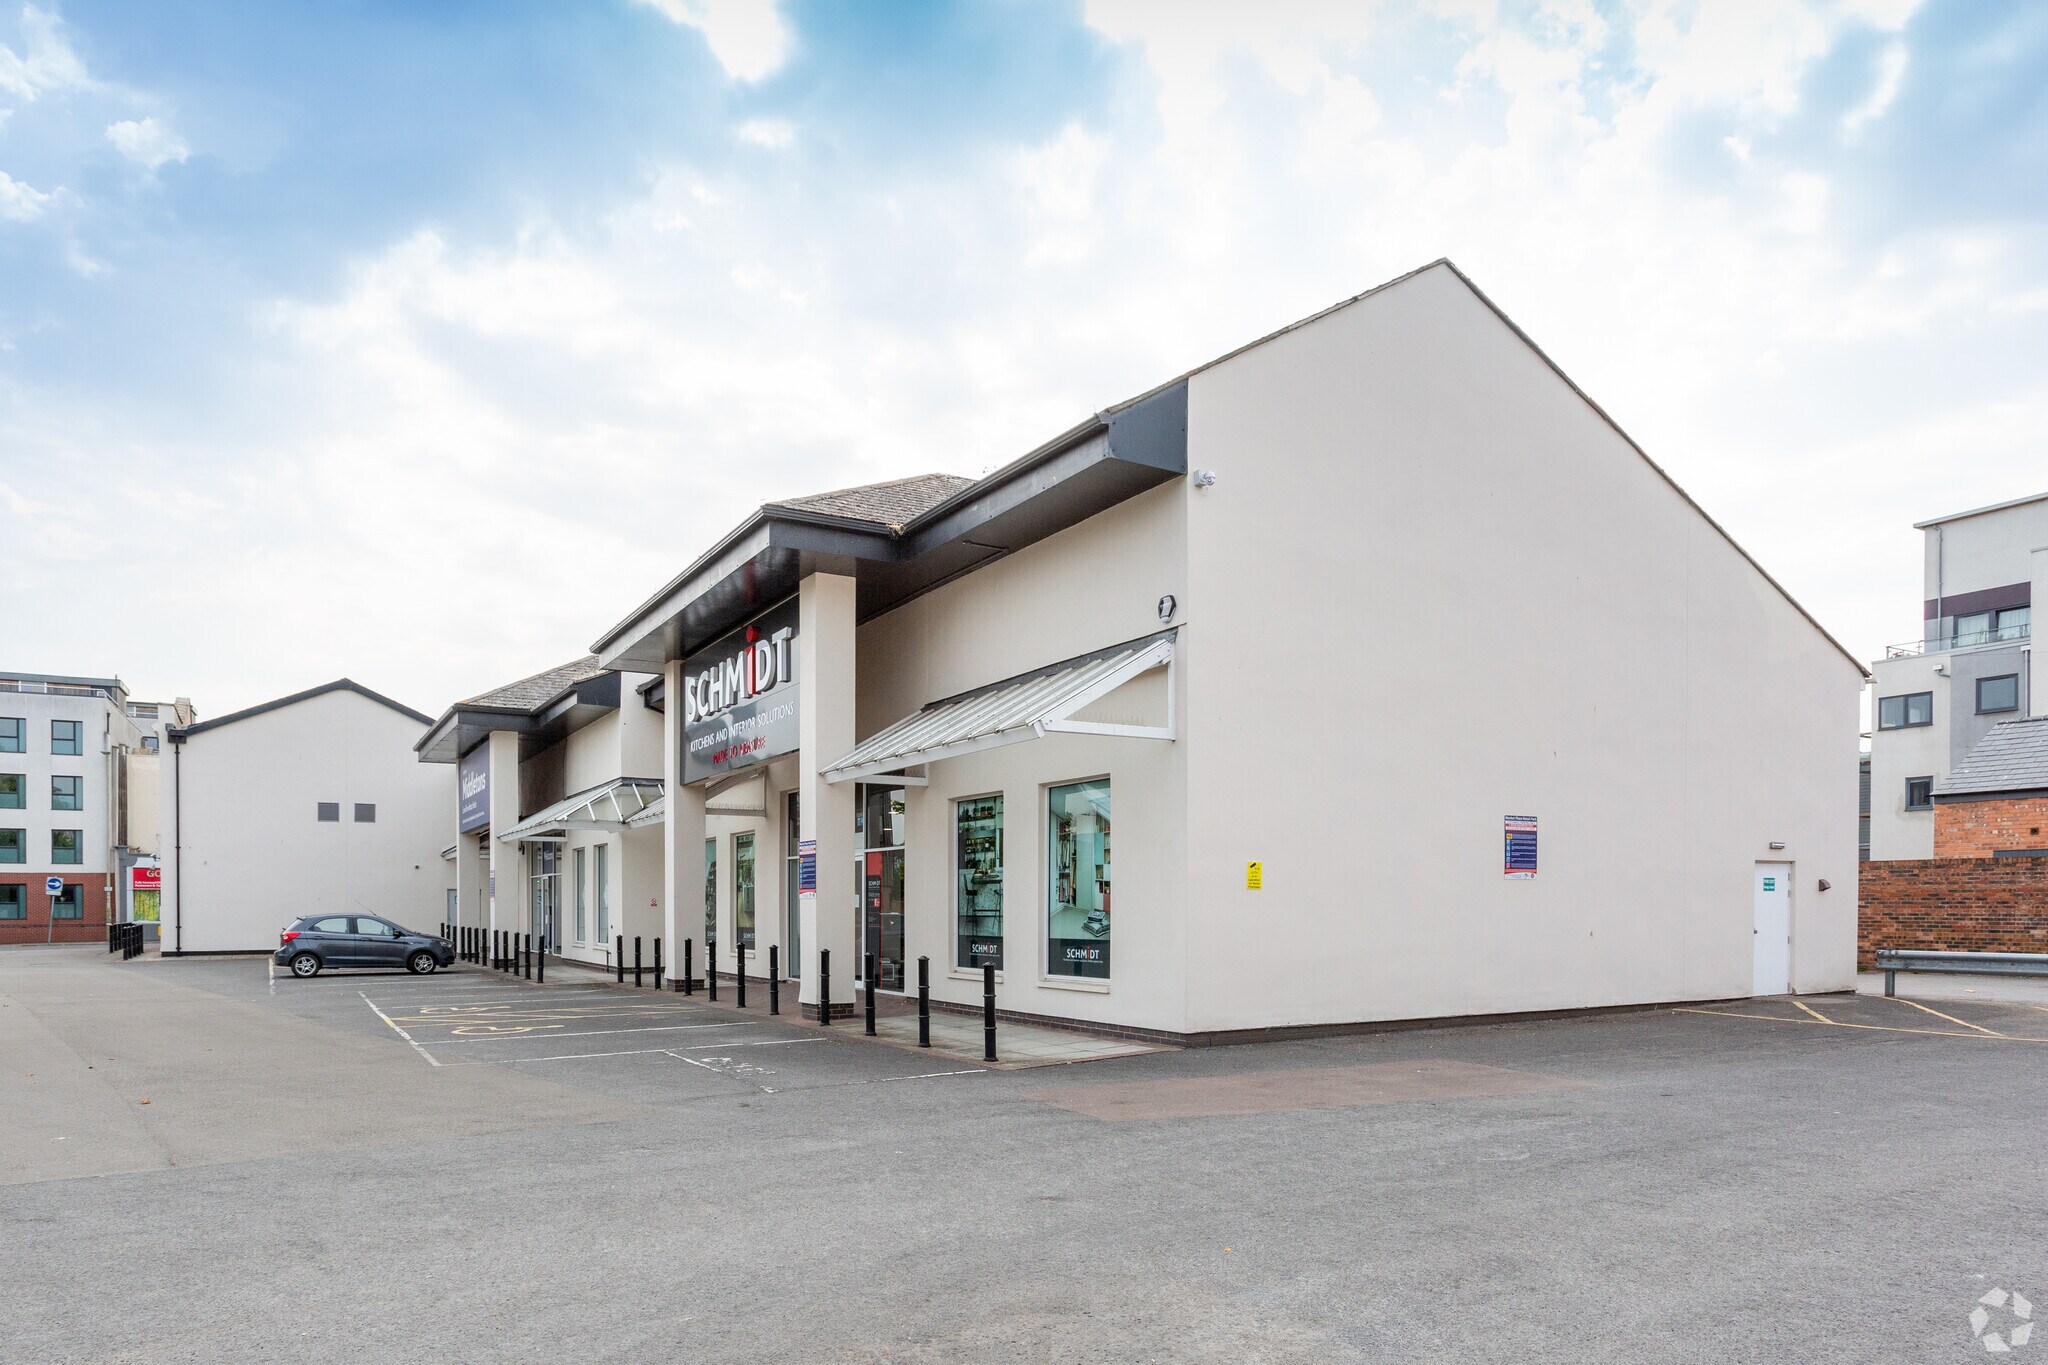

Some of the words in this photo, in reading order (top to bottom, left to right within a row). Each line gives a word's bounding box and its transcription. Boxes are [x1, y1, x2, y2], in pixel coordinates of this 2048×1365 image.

[690, 733, 714, 753] KITCHENS
[715, 728, 728, 743] AND
[729, 717, 756, 738] INTERIOR
[757, 701, 795, 727] SOLUTIONS
